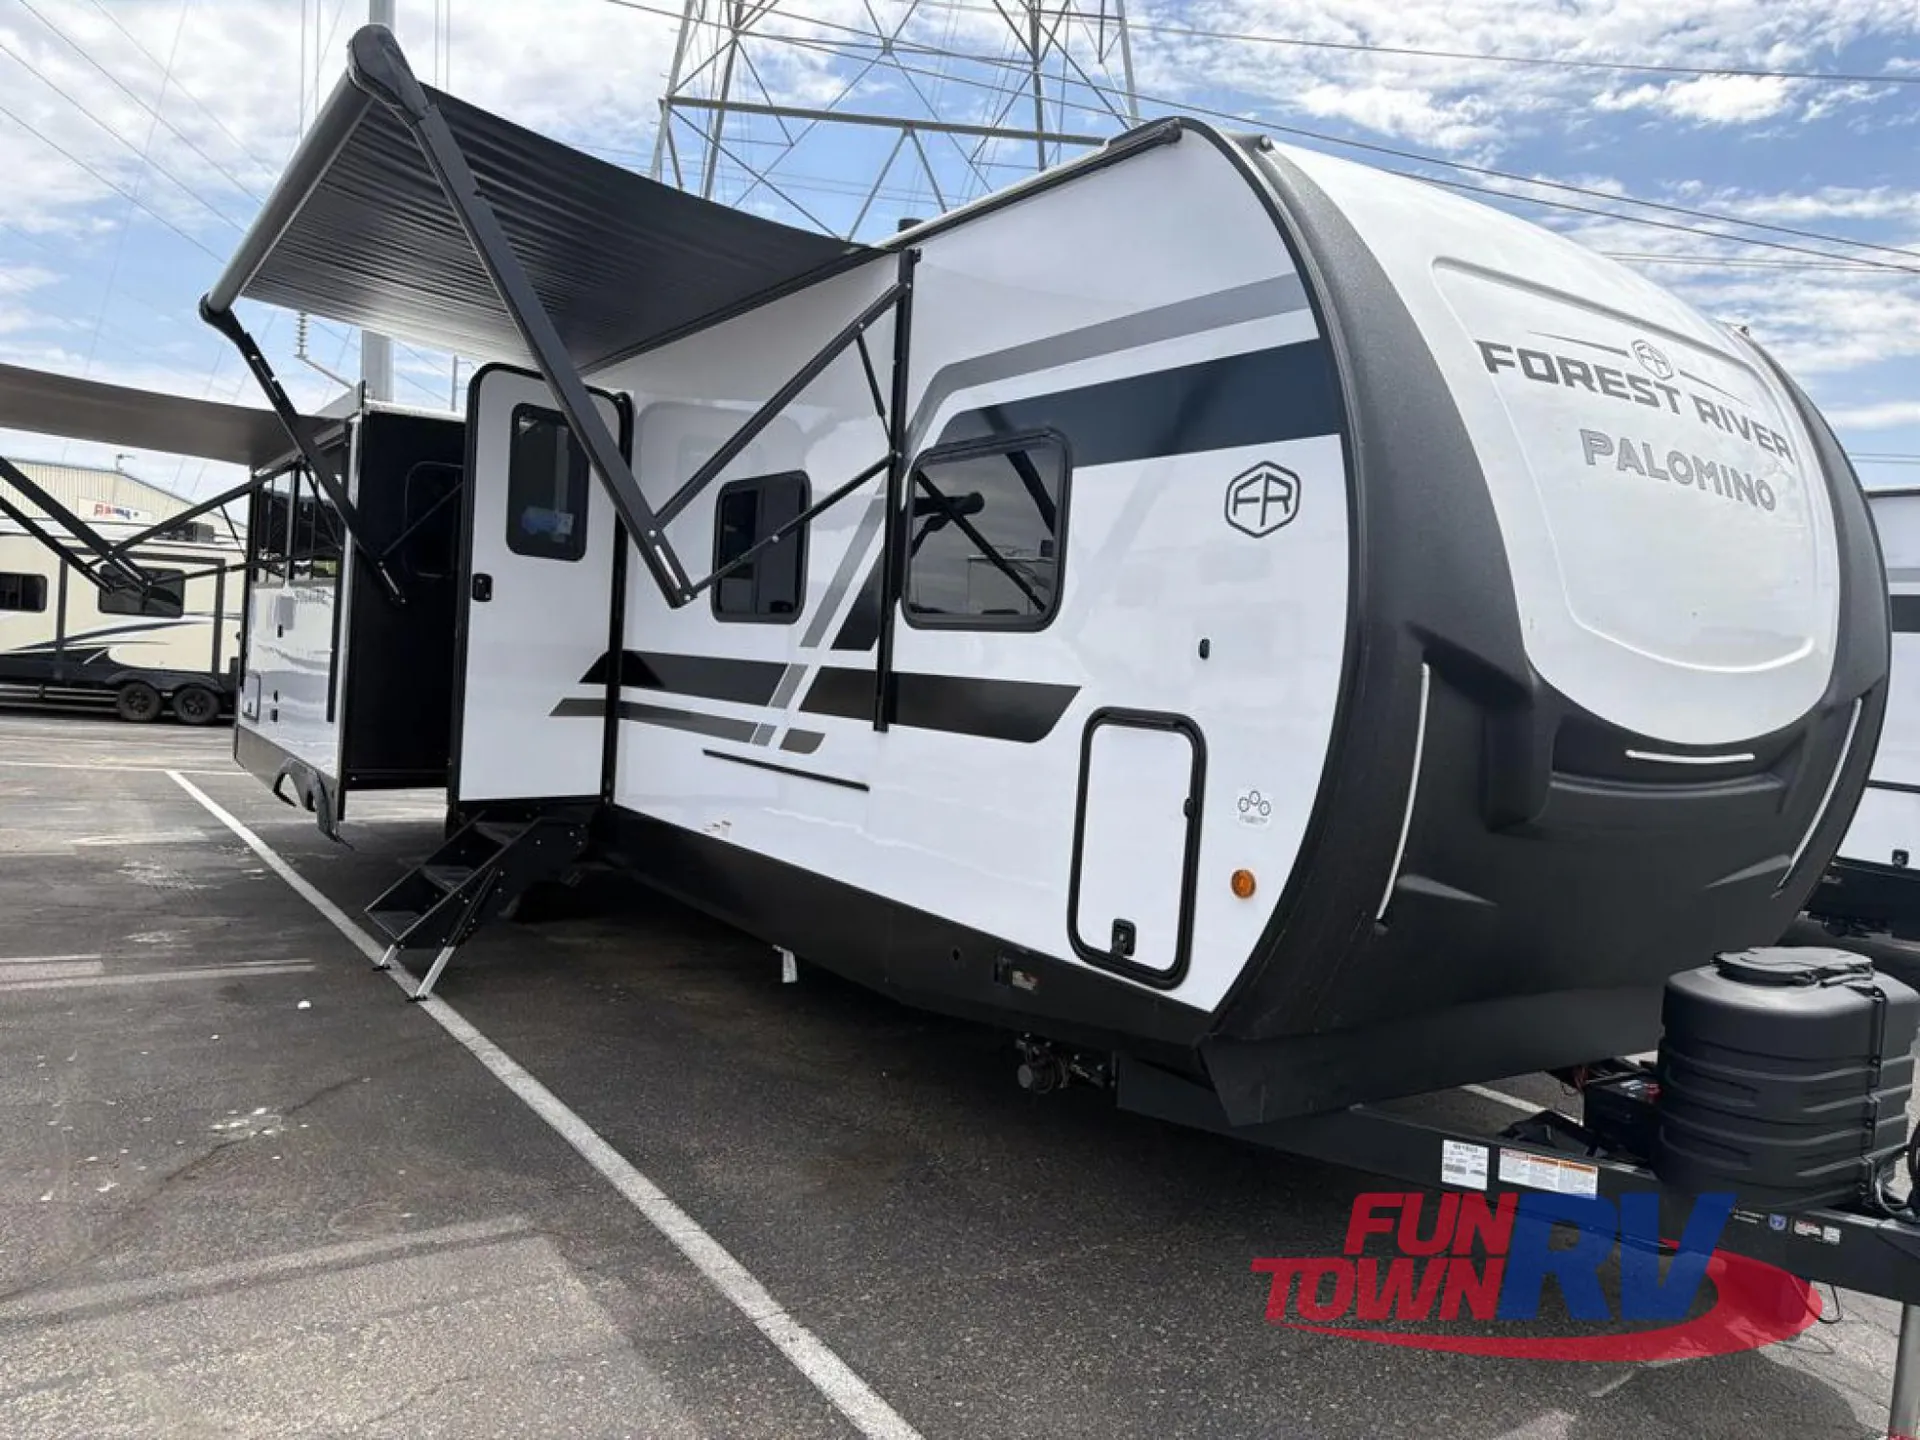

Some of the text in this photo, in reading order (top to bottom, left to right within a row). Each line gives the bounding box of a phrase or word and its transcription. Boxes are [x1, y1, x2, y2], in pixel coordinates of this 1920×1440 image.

[1475, 339, 1796, 465] FOREST RIVER
[1579, 428, 1776, 512] PALOMINO
